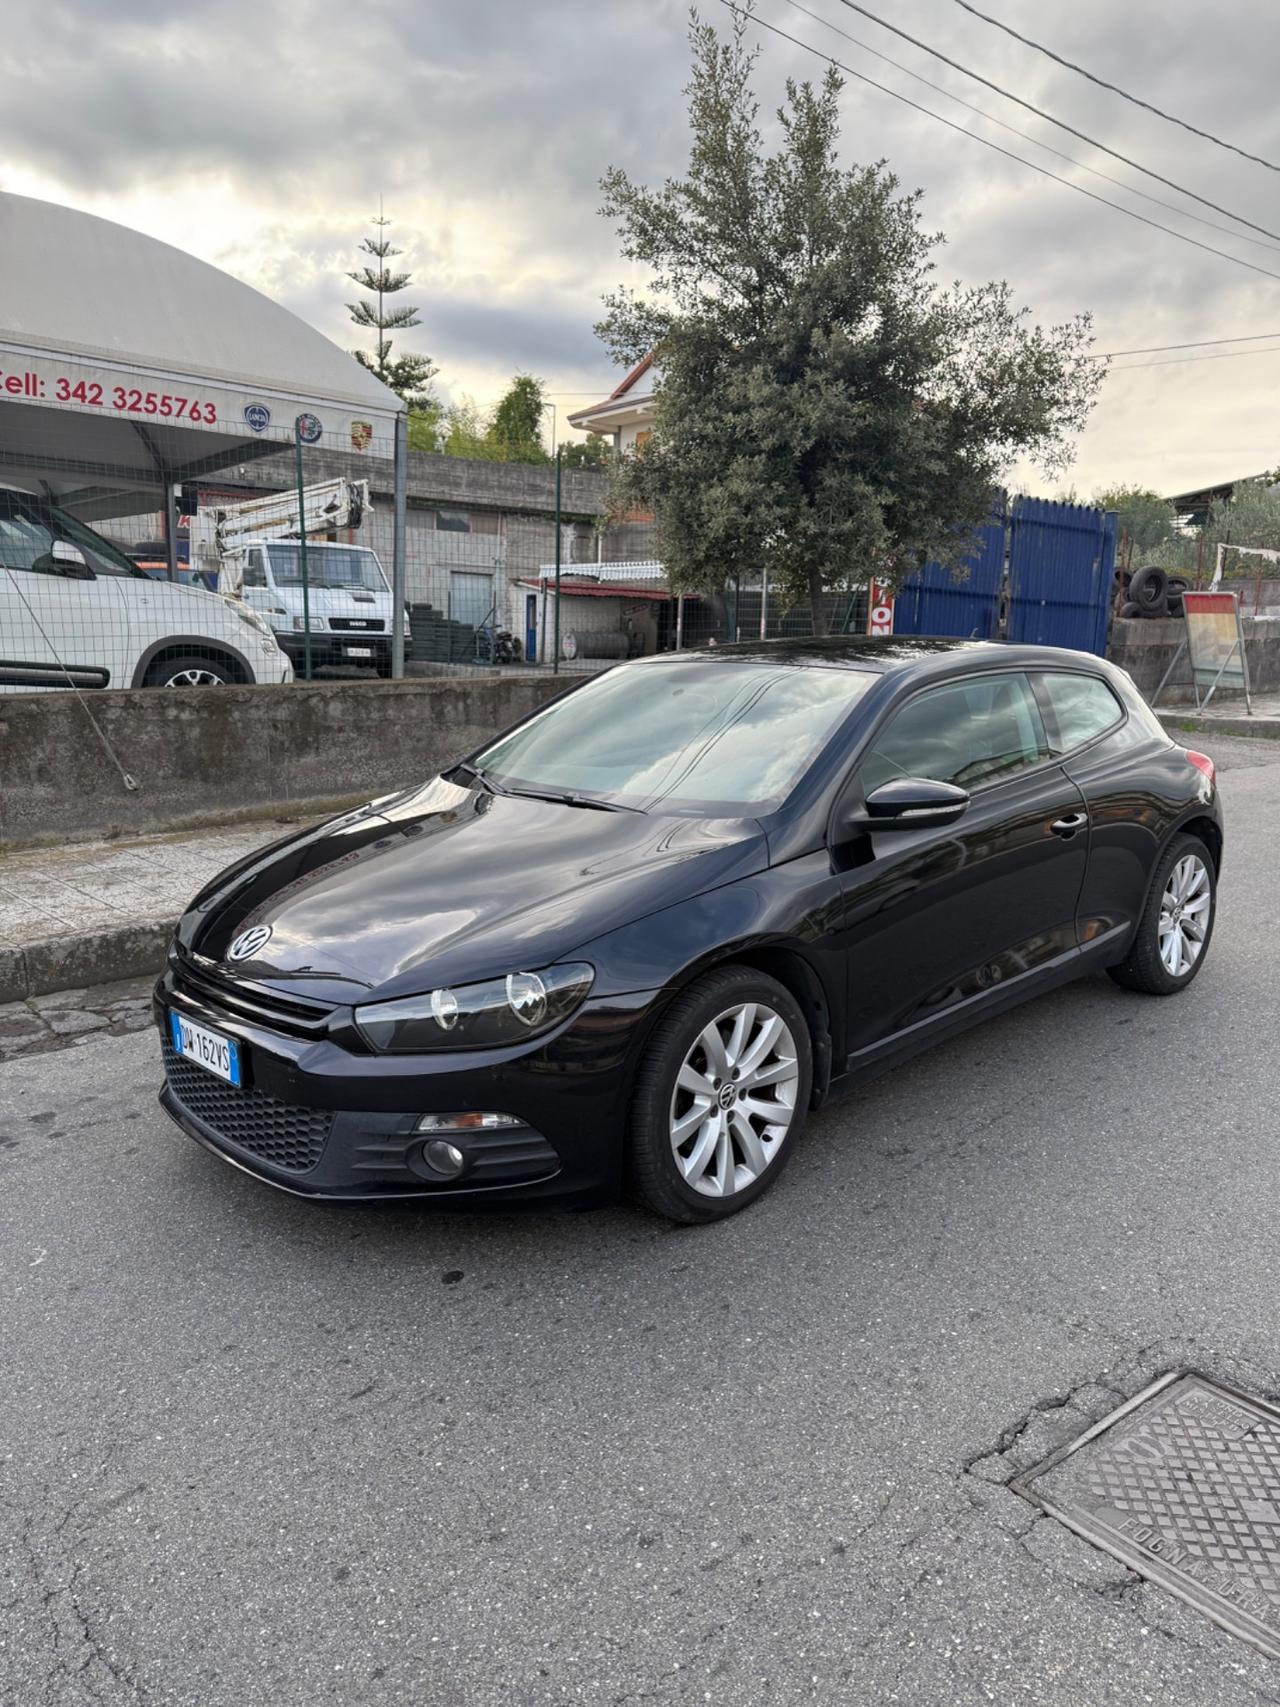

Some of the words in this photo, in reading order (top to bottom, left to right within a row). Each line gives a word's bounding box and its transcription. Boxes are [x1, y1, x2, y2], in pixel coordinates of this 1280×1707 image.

[0, 370, 45, 397] ell:
[56, 378, 103, 406] 342
[112, 387, 216, 424] 3255763
